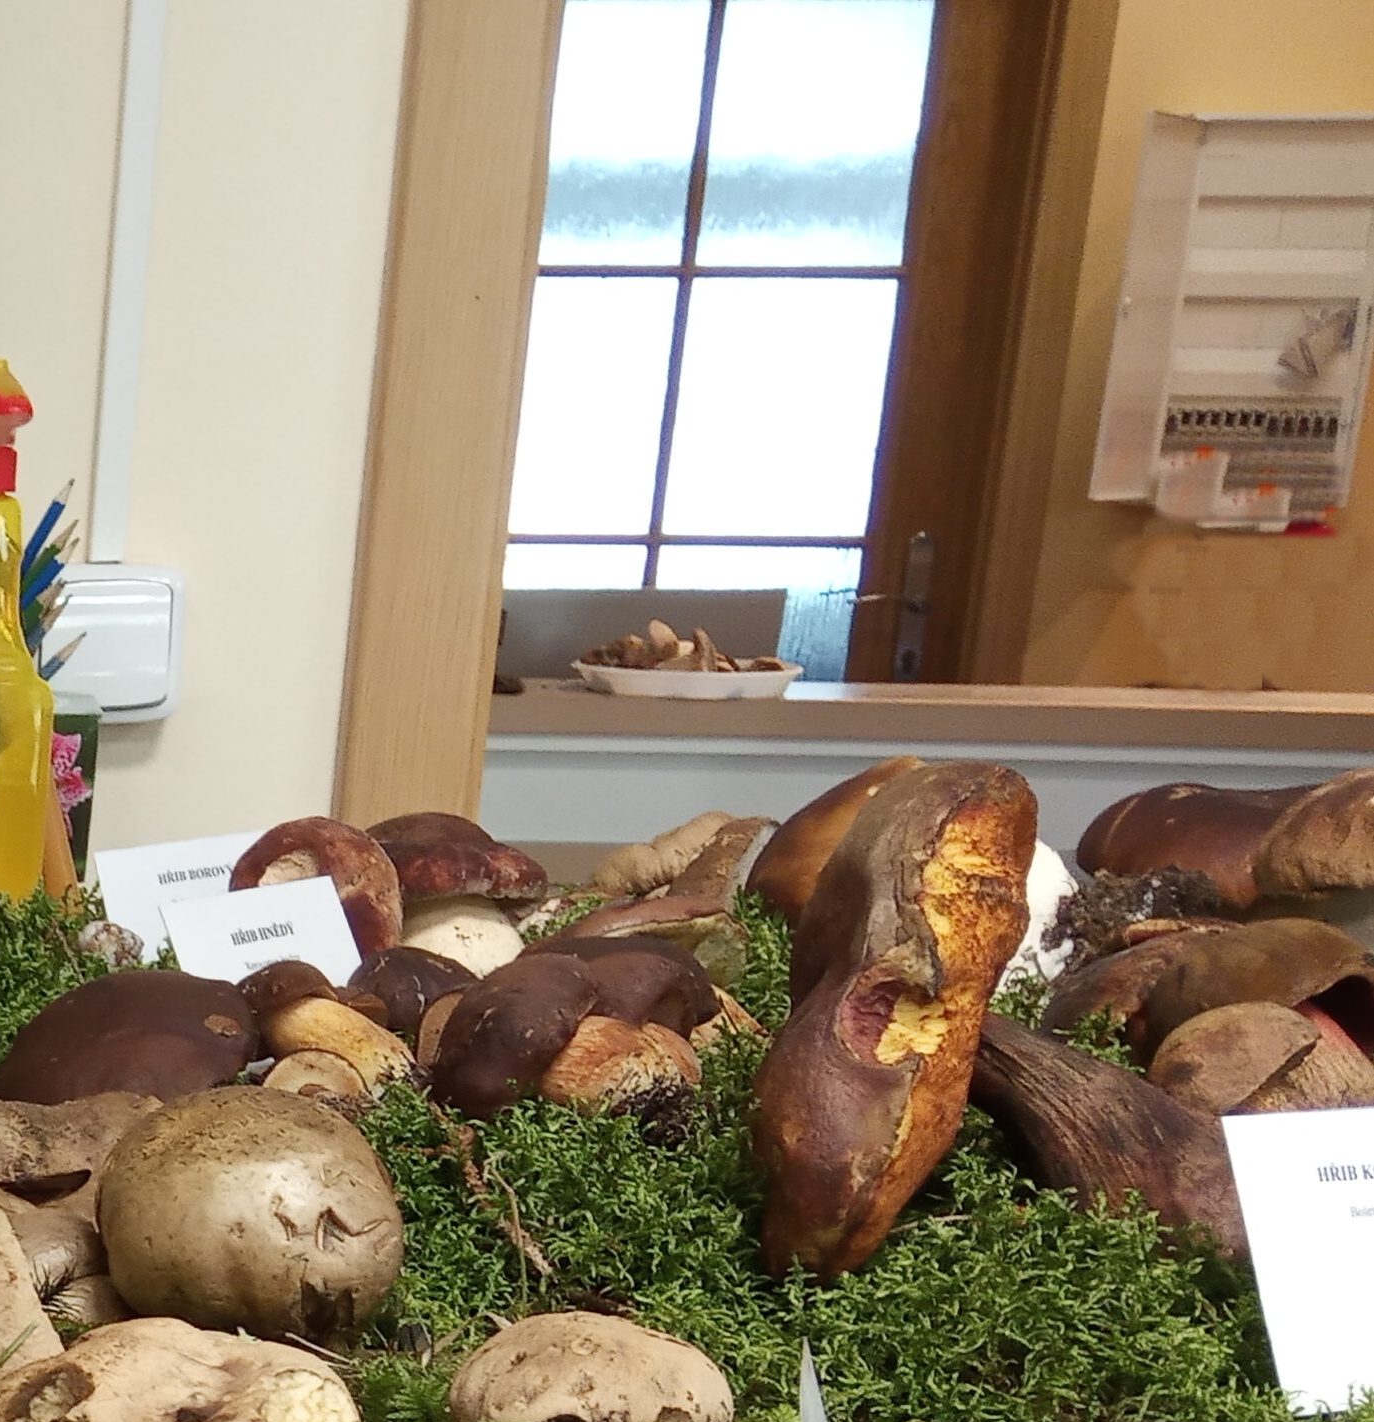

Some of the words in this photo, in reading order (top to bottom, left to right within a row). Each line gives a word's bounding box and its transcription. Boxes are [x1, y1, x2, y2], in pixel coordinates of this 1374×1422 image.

[157, 868, 187, 885] HŘIB
[230, 927, 258, 946] HŘIB
[257, 920, 294, 941] HNĚDÝ
[1317, 1161, 1358, 1182] HŘIB
